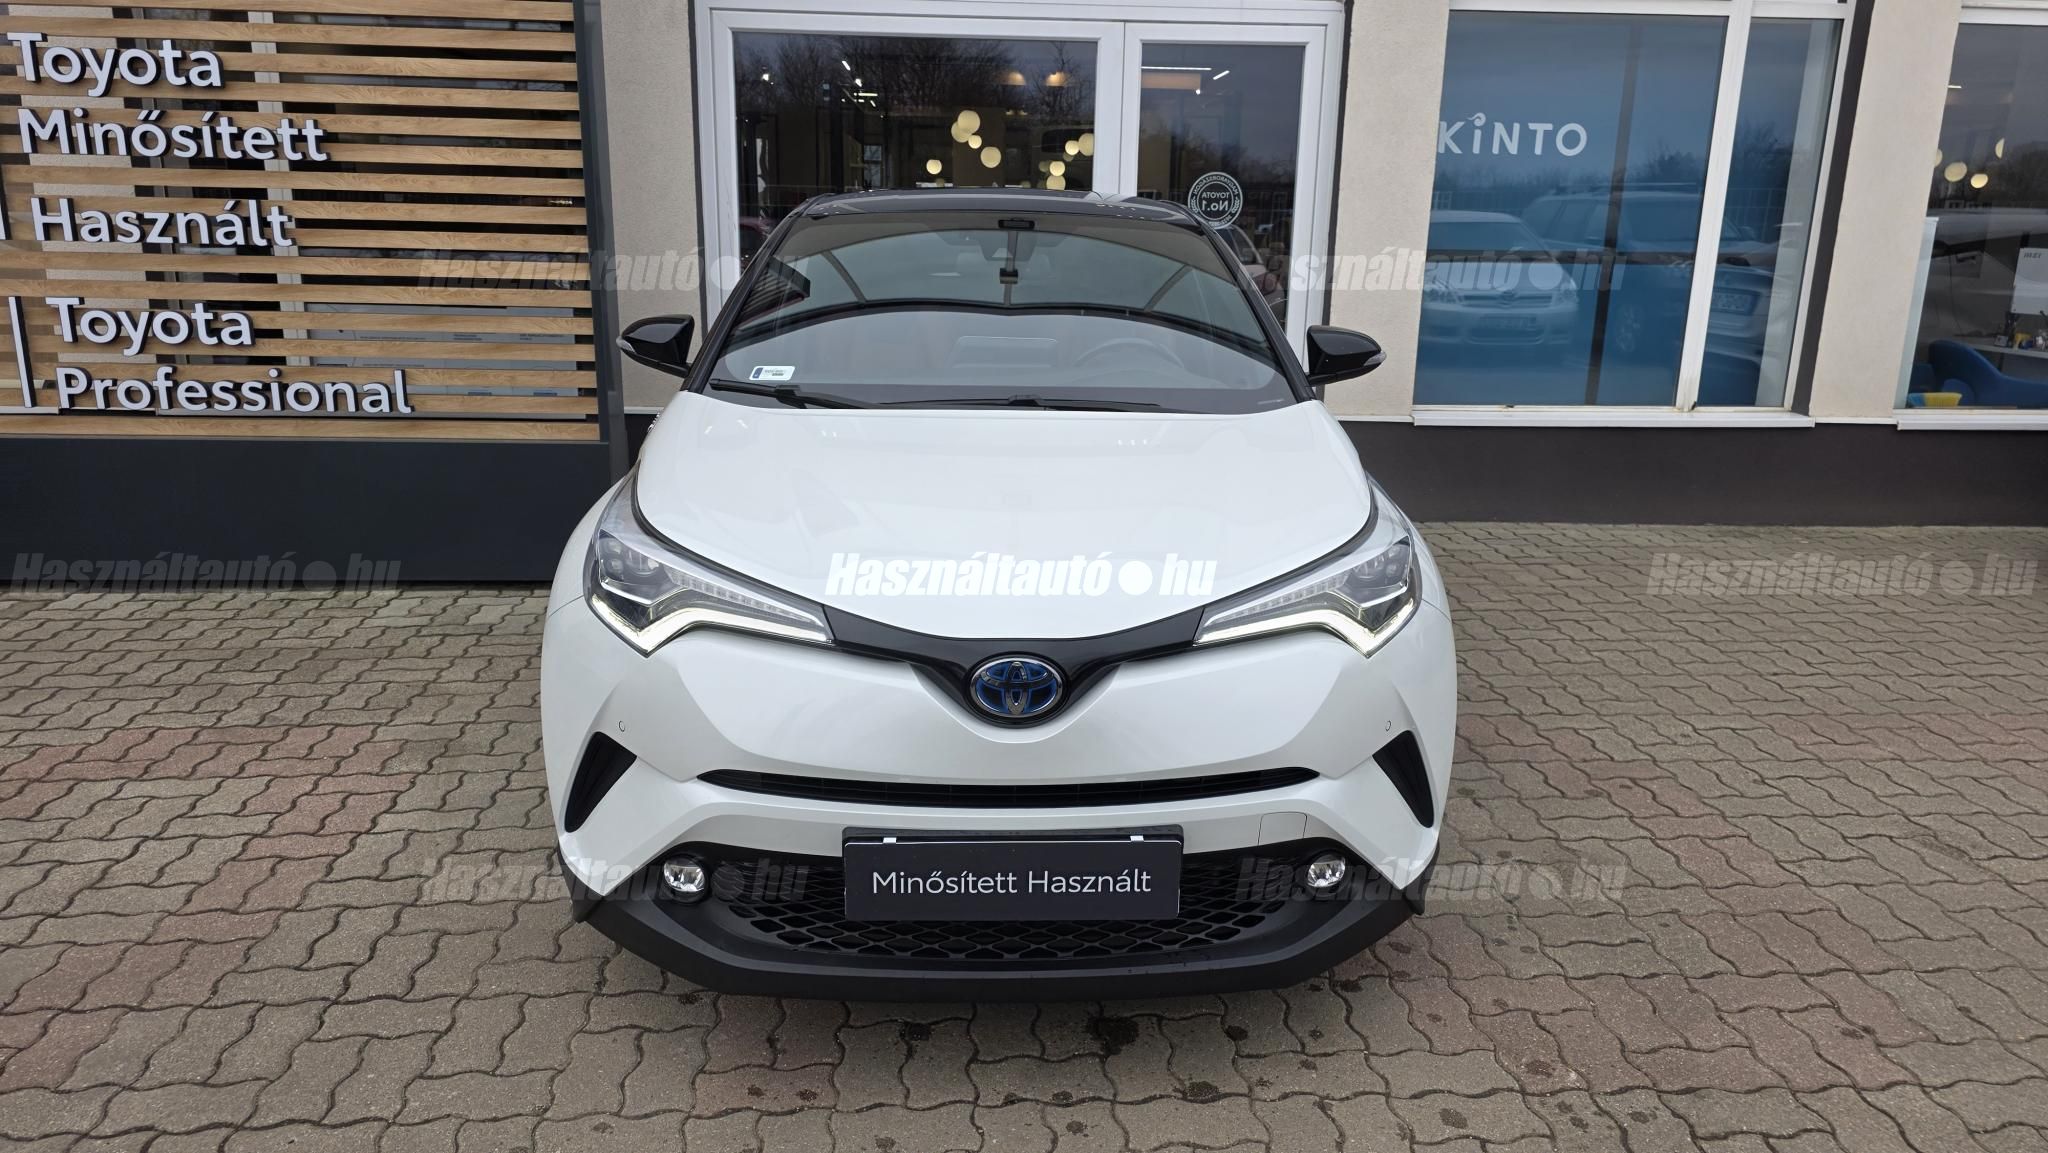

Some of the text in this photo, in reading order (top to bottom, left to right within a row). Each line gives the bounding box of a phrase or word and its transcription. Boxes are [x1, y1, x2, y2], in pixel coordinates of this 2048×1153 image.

[8, 32, 223, 96] Toyota
[18, 108, 330, 161] Minősített
[31, 198, 296, 248] Használt
[46, 296, 254, 356] Toyota
[56, 368, 413, 416] Professional
[872, 868, 1152, 895] Minősített Használt
